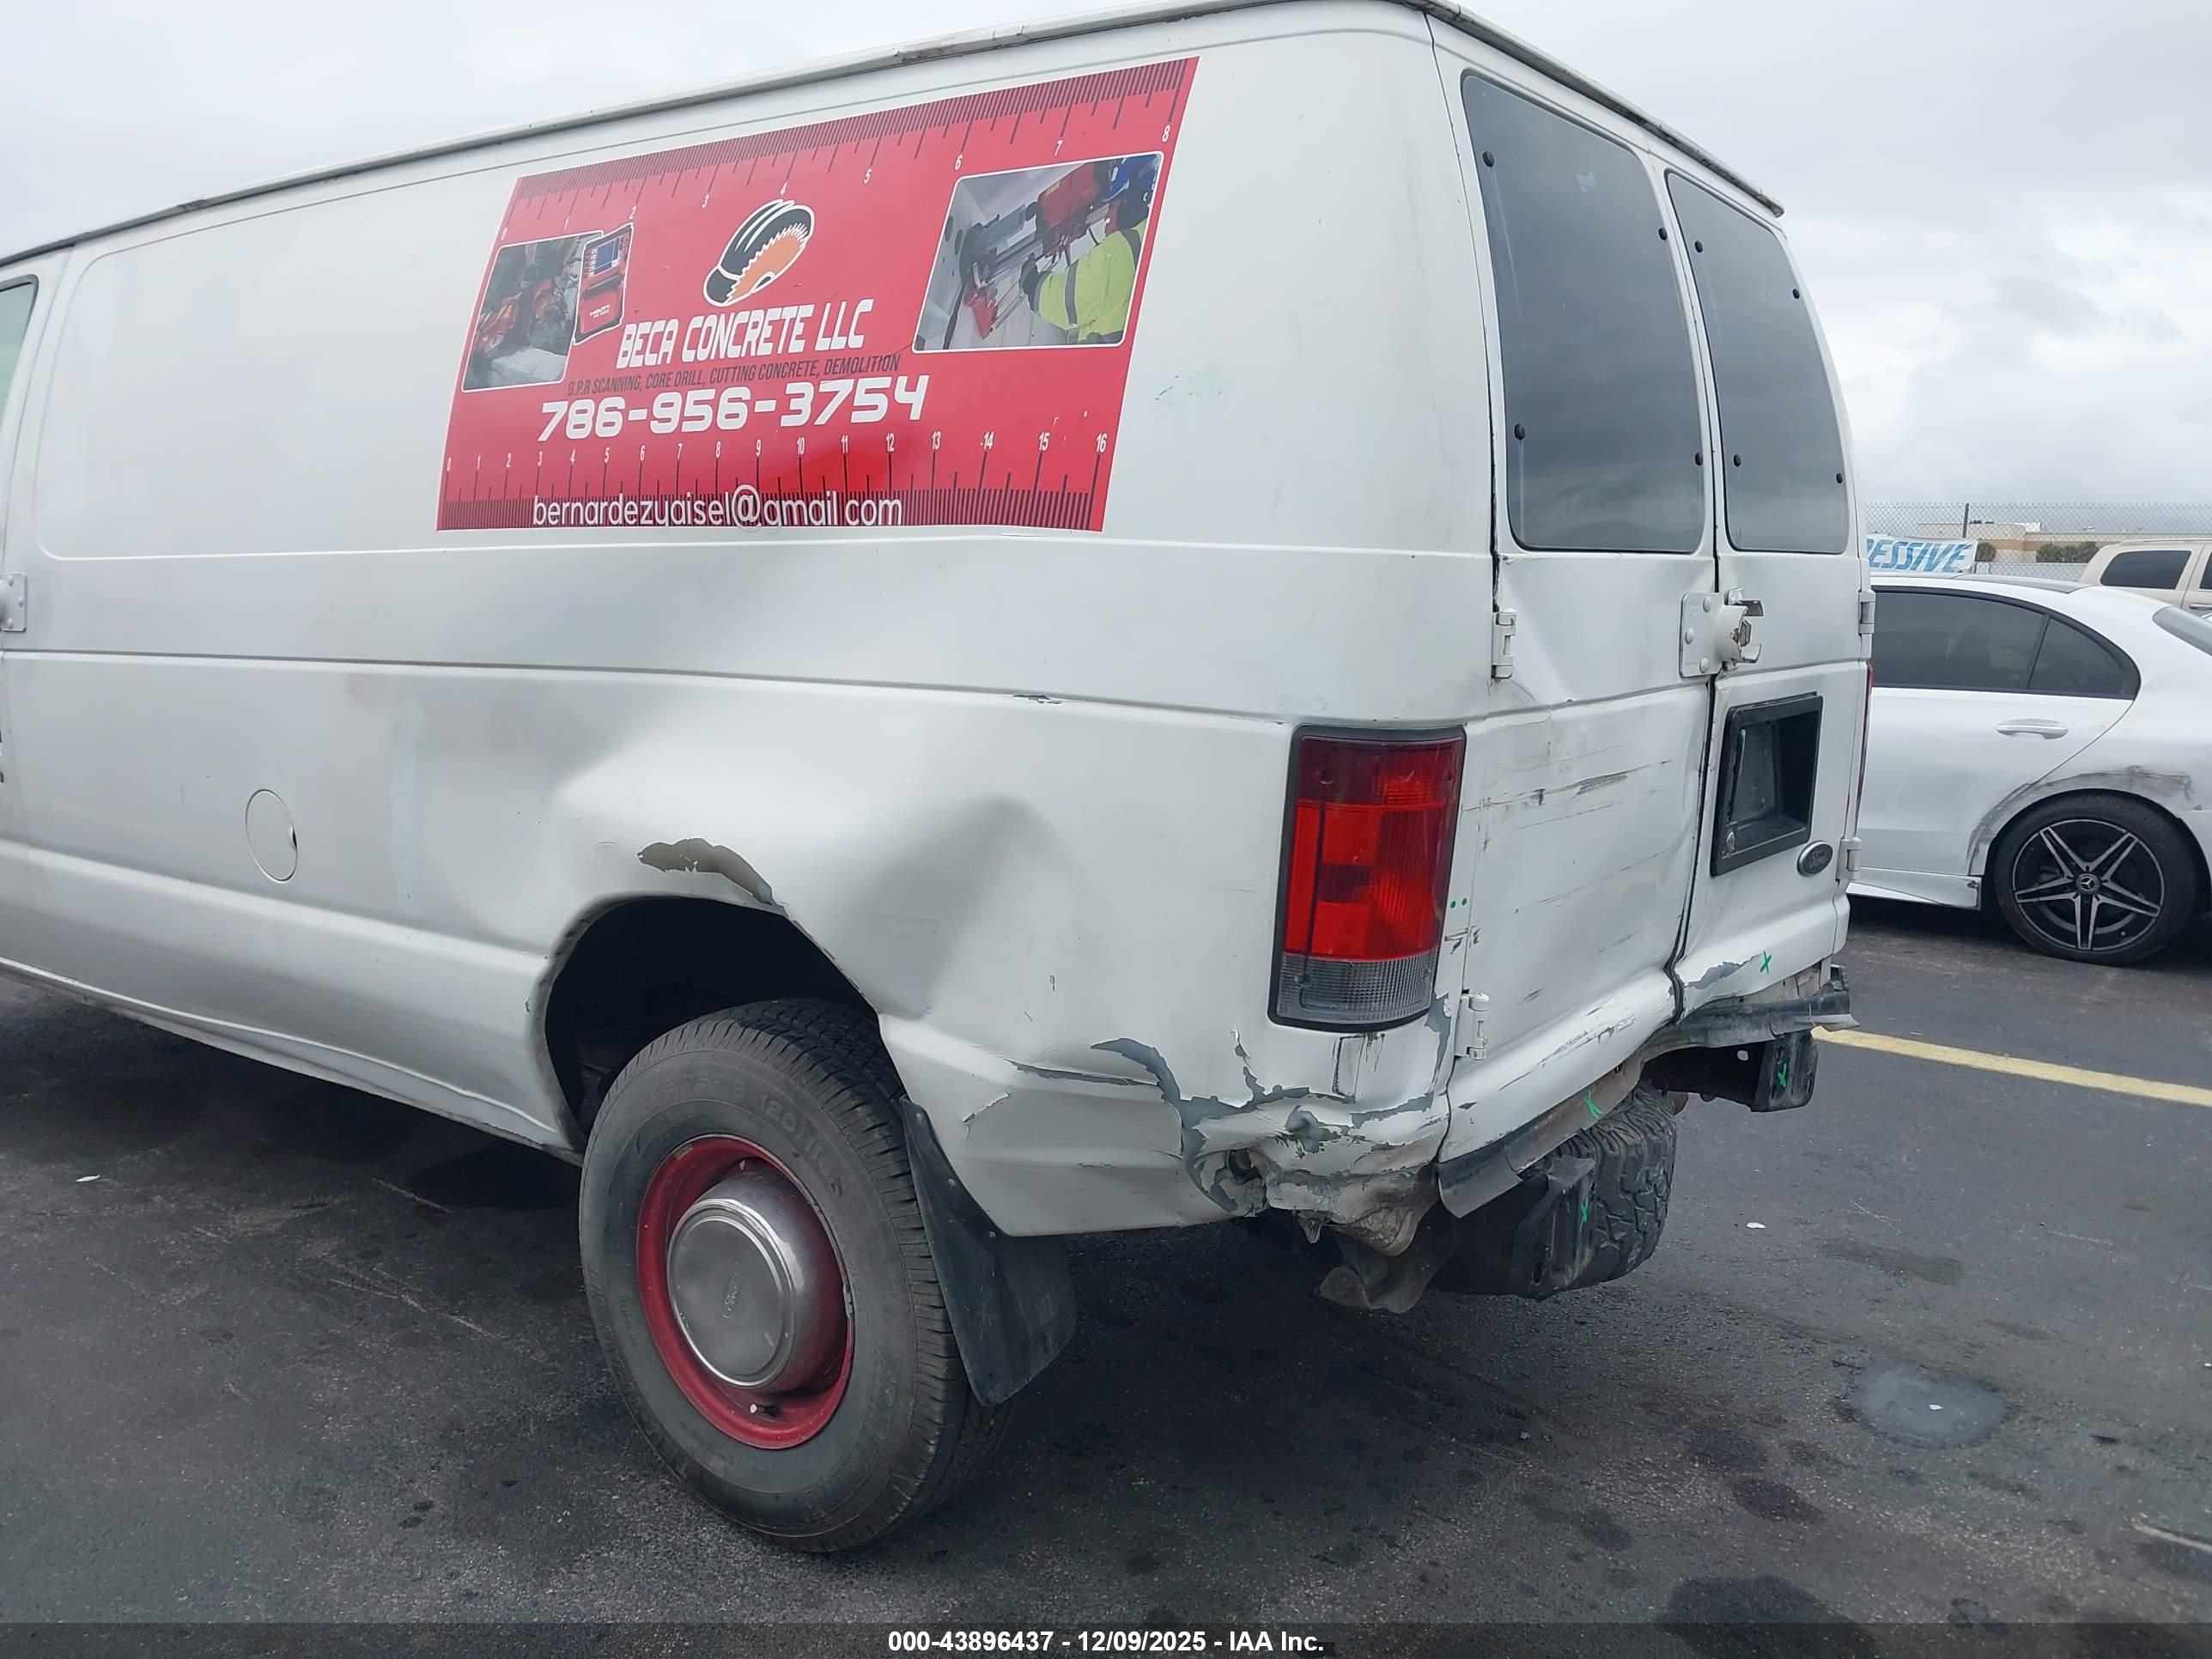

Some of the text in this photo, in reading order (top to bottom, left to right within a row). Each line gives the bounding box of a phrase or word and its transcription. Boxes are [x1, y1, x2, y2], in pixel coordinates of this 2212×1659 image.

[628, 205, 637, 220] 2
[702, 194, 709, 209] 3
[780, 182, 787, 197] 4
[863, 168, 872, 184] 5
[955, 155, 963, 171] 6
[1054, 140, 1063, 156] 7
[1162, 125, 1170, 143] 8
[616, 298, 874, 369] BECA CONCRETE LLC
[537, 374, 930, 441] 786-956-3754
[592, 374, 643, 394] SCANNING,
[645, 370, 673, 389] CORE
[674, 367, 706, 387] DRILL,
[709, 363, 757, 385] CUTTING
[758, 358, 820, 383] CONCRETE,
[823, 354, 901, 376] DEMOLITION
[447, 431, 1108, 471] 0 1 2 3 4 5 6 7 8 9 10 11 12 13 14 15 16
